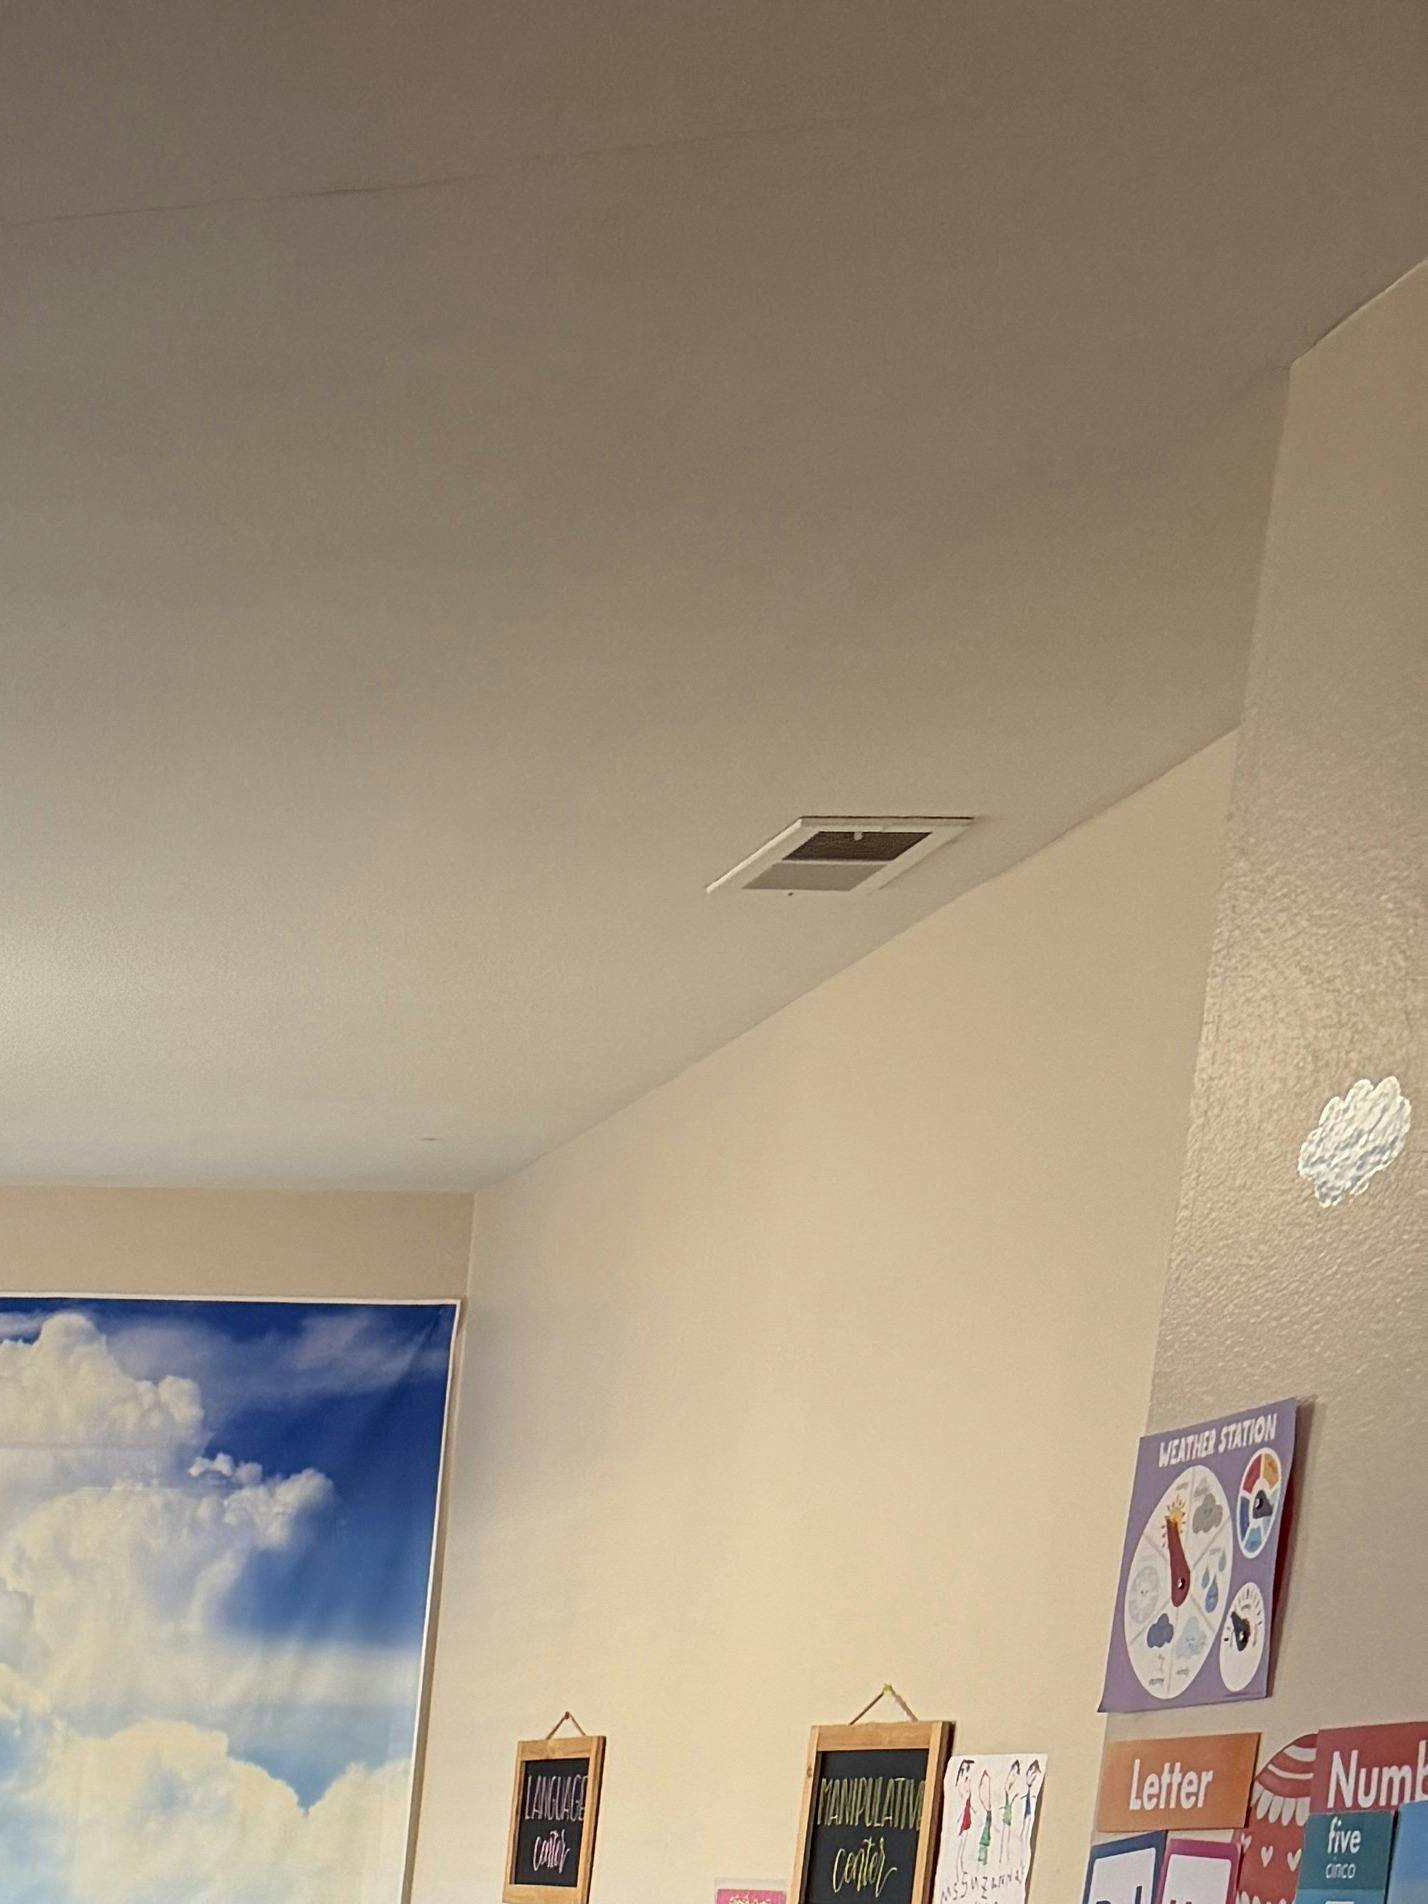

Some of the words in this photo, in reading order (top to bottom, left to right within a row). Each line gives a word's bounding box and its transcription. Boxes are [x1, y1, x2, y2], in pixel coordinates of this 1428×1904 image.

[1159, 1427, 1215, 1468] WEATHER
[1218, 1413, 1278, 1454] STATION
[1128, 1757, 1214, 1812] Letter
[1327, 1816, 1362, 1854] five
[1325, 1863, 1356, 1879] cinco
